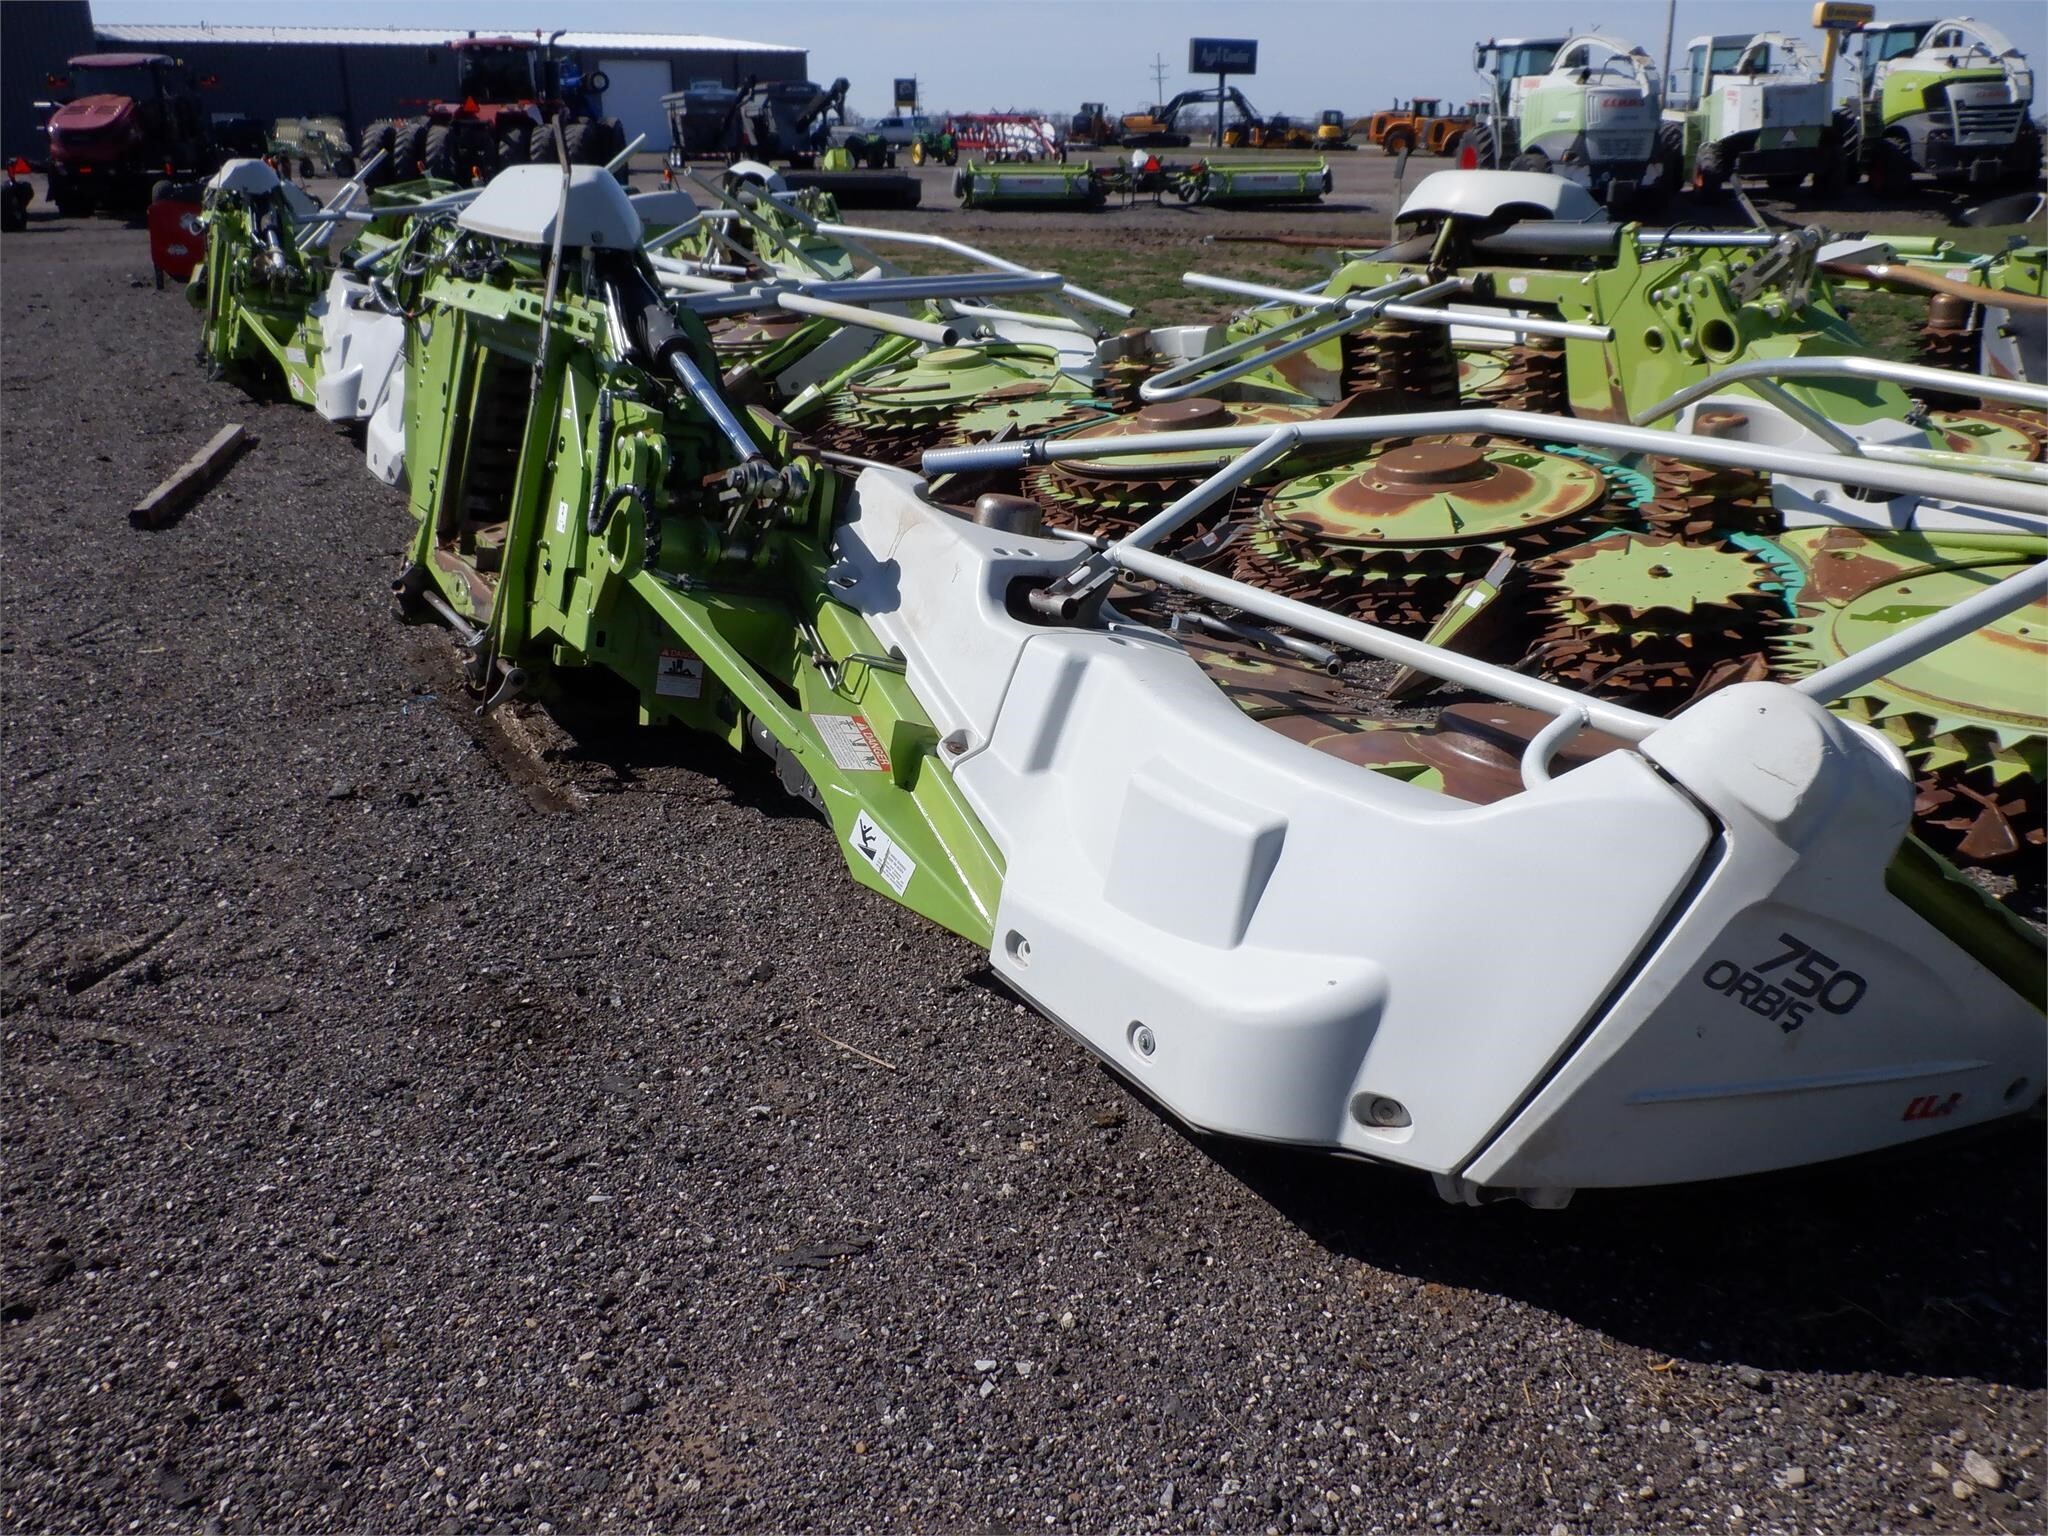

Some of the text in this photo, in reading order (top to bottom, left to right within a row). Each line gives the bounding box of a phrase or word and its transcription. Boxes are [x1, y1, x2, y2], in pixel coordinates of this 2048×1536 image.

[863, 732, 889, 765] DANGER
[1702, 959, 1815, 1034] ORBIS
[1752, 932, 1867, 1015] 750
